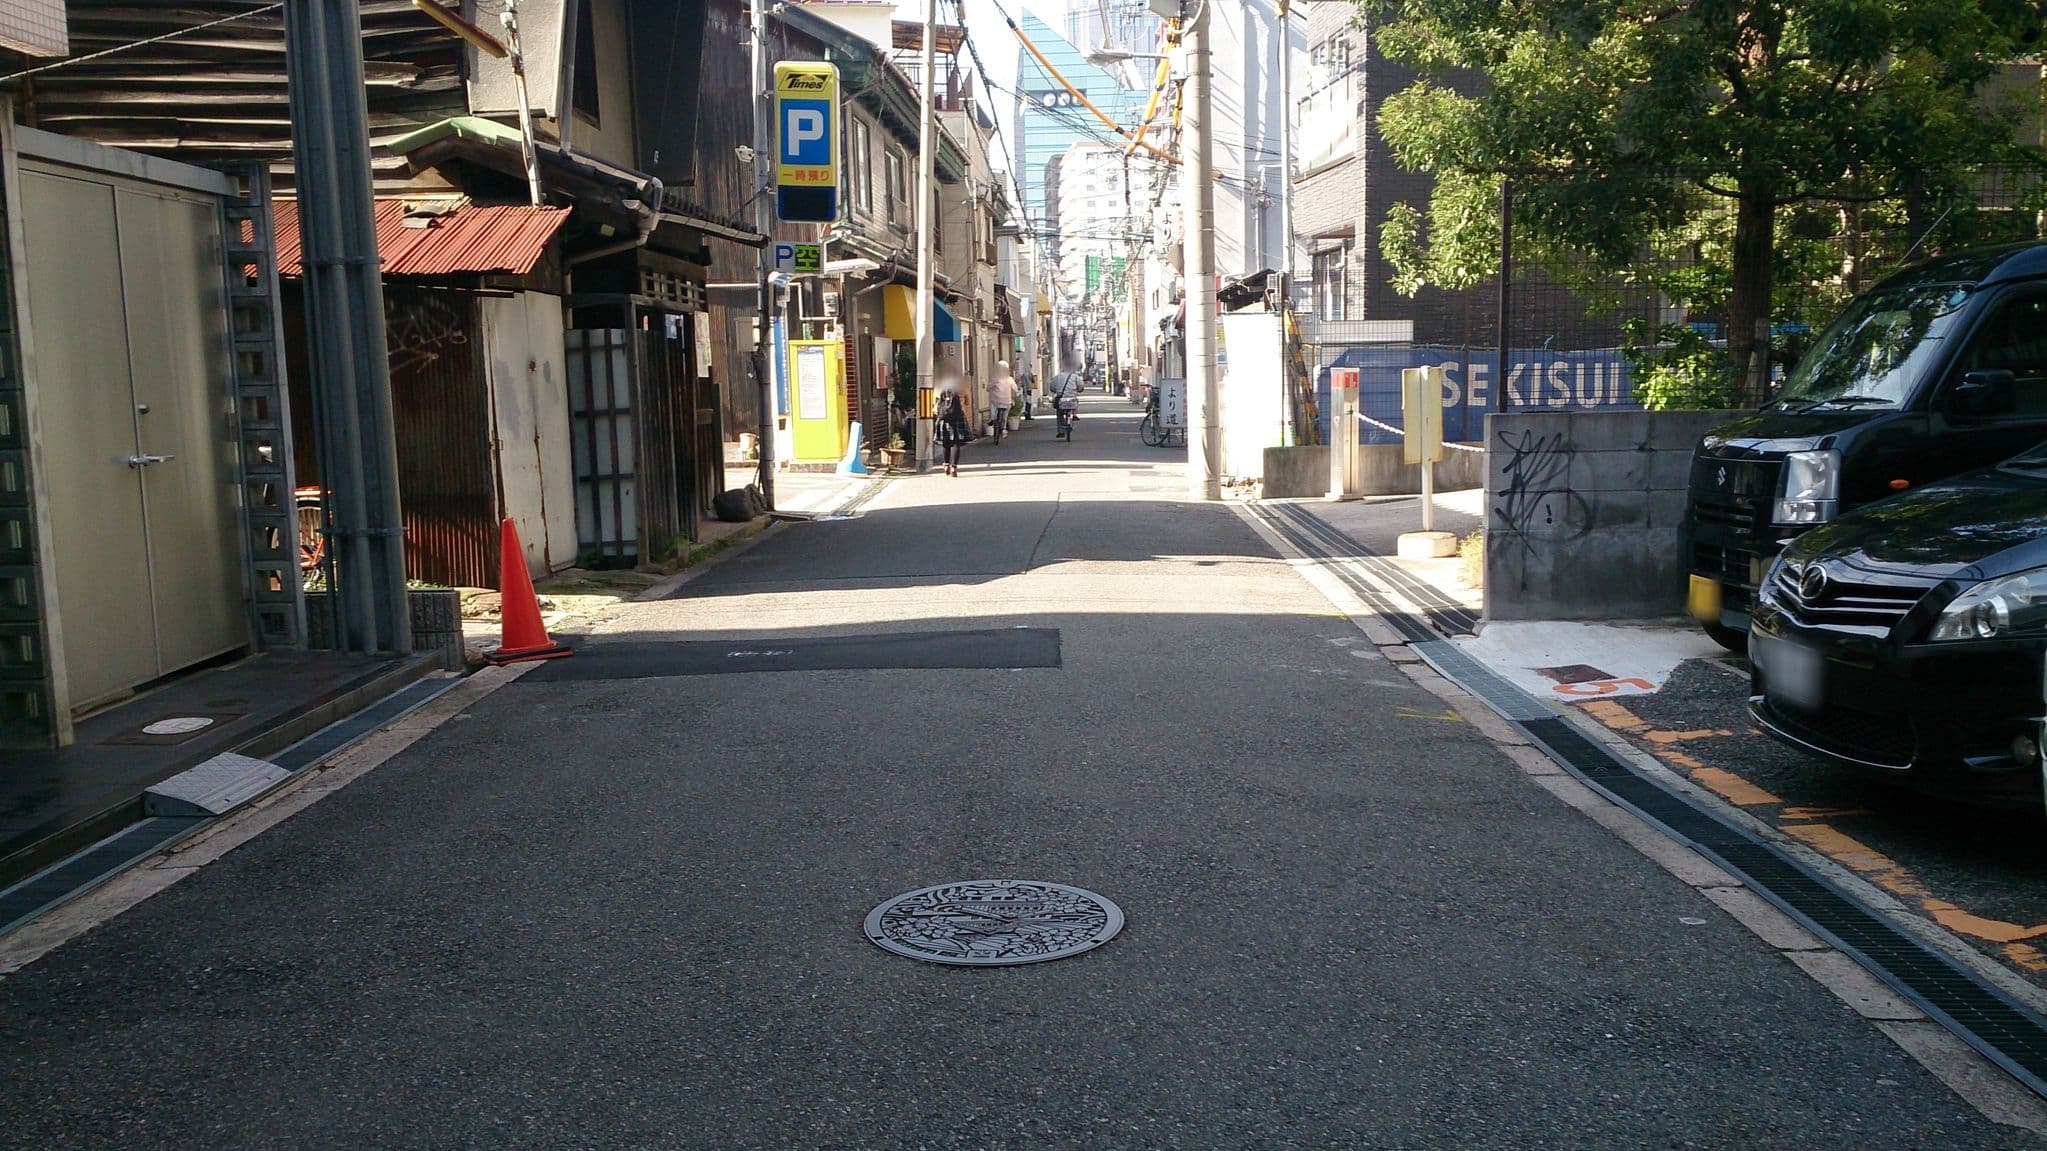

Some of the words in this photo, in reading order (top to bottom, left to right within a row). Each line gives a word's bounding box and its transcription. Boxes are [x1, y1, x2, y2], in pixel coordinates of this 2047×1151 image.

[786, 74, 827, 89] Times
[788, 109, 824, 155] P
[775, 244, 794, 268] P
[1441, 361, 1620, 408] SEKISUI
[1166, 386, 1179, 425] より道
